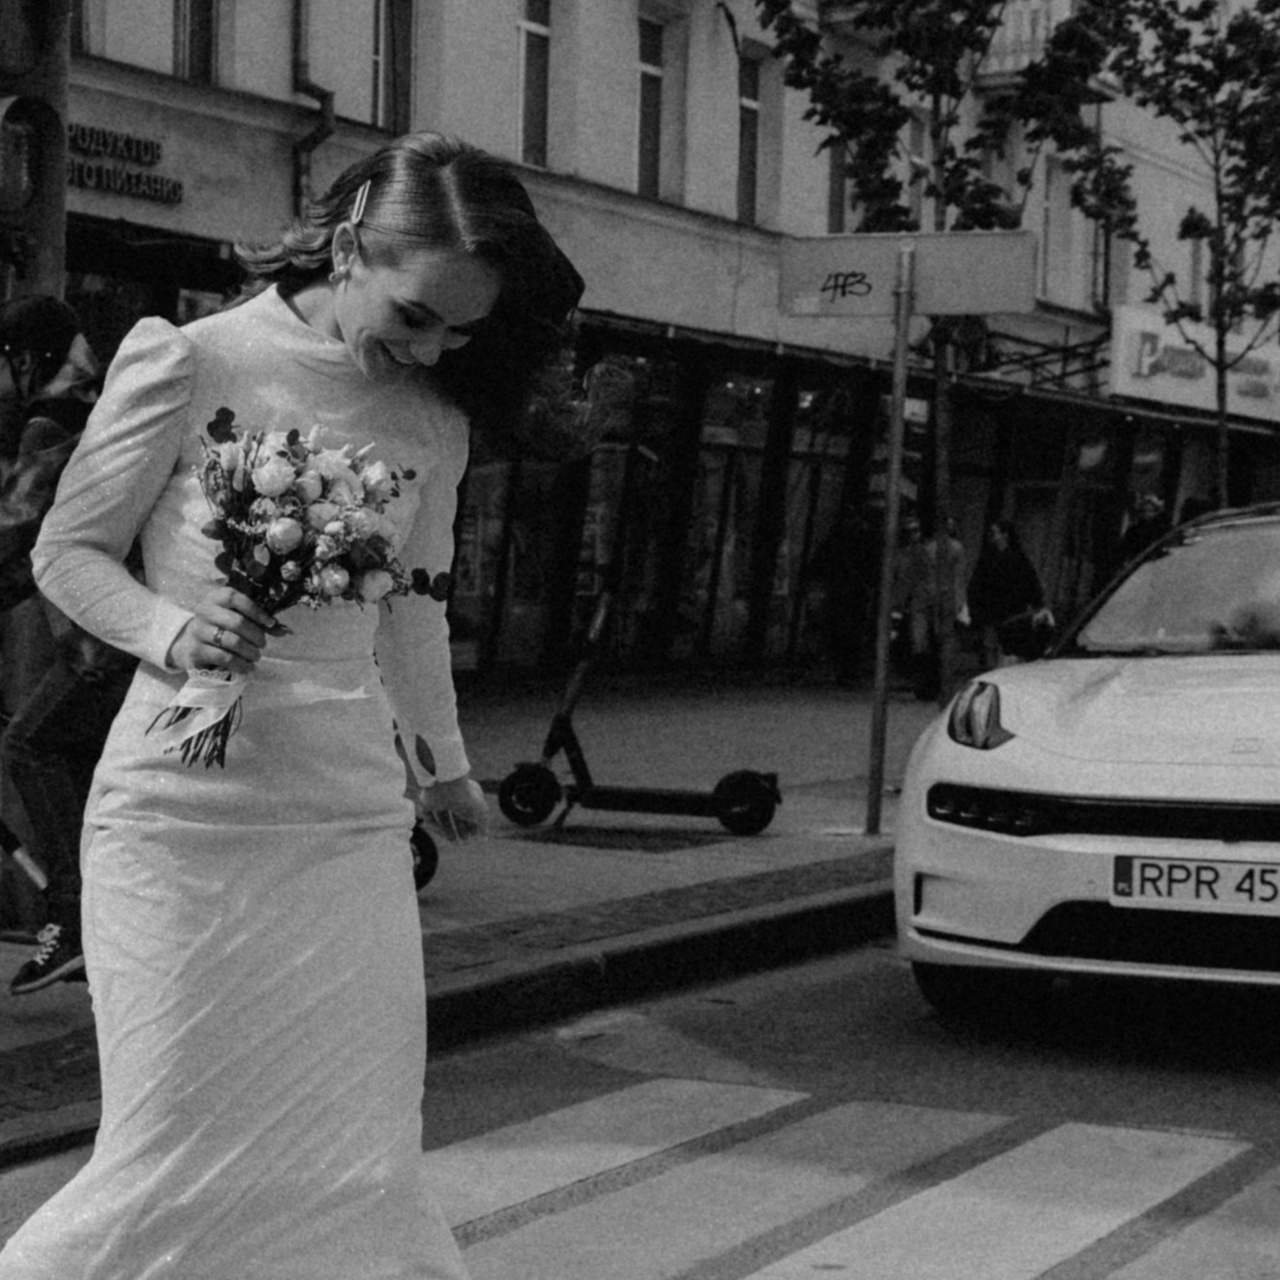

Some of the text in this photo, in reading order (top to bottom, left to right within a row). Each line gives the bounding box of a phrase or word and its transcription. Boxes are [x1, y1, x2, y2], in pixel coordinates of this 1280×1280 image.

[66, 123, 163, 167] РОДУКТОВ
[1140, 862, 1279, 902] RPR 45
